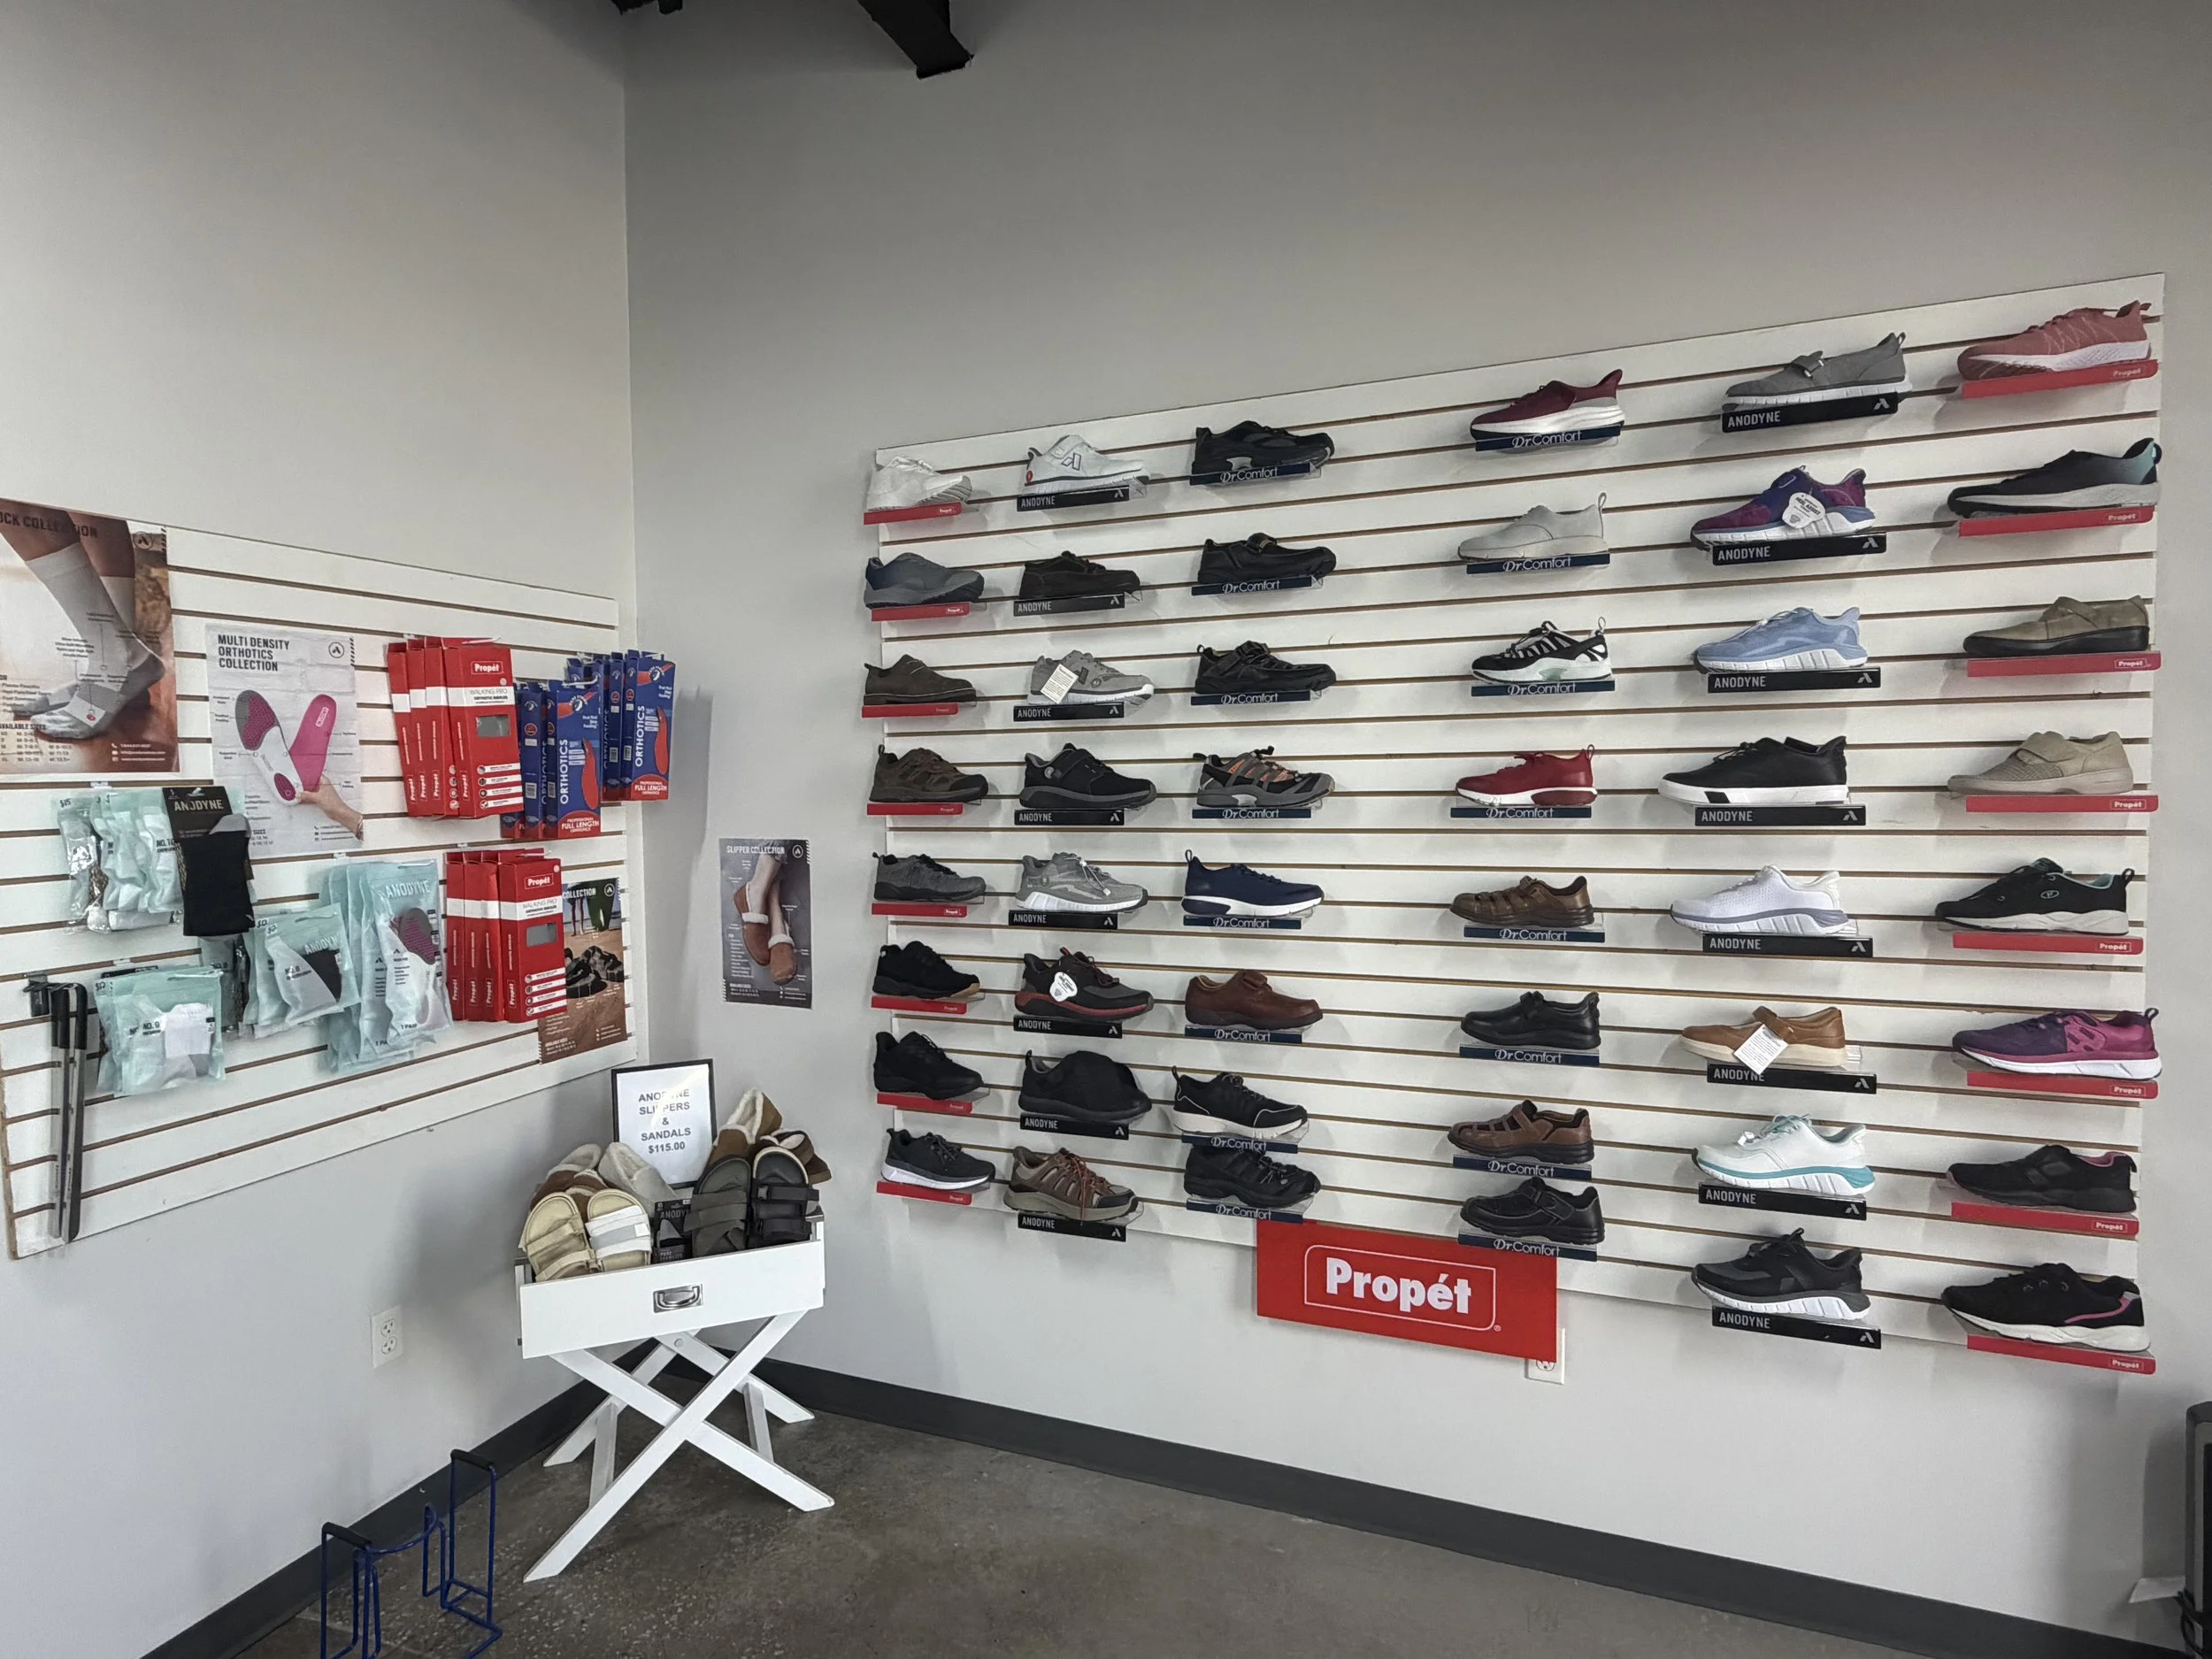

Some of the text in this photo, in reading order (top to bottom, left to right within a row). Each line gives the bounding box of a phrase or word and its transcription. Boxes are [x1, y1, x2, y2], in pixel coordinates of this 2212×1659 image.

[1728, 411, 1781, 428] ANODYNE
[1021, 495, 1056, 508] ANODYNE
[1717, 546, 1770, 562] ANODYNE
[1018, 602, 1052, 613] ANODYNE
[218, 634, 290, 650] MULTI DENSITY
[218, 646, 273, 660] ORTHOTICS
[219, 657, 279, 672] COLLECTION
[1714, 676, 1767, 688] ANODYNE
[1018, 709, 1052, 718] ANODYNE
[635, 705, 645, 768] ORTHOTICS
[560, 739, 569, 804] ORTHOTICS
[1018, 813, 1053, 822] ANODYNE
[1701, 810, 1753, 822] ANODYNE
[387, 879, 431, 899] ANODYNE
[563, 887, 596, 900] COLLECTION
[1013, 913, 1048, 924] ANODYNE
[1709, 938, 1762, 950] ANODYNE
[1018, 1019, 1052, 1031] ANODYNE
[1714, 1067, 1766, 1082] ANODYNE
[662, 1117, 670, 1125] &
[1025, 1118, 1058, 1129] ANODYNE
[641, 1127, 691, 1142] SANDALS
[648, 1141, 686, 1155] $115.00
[1705, 1188, 1756, 1205] ANODYNE
[1022, 1217, 1056, 1229] ANODYNE
[1326, 1256, 1472, 1315] Propét
[1719, 1311, 1770, 1329] ANODYNE
